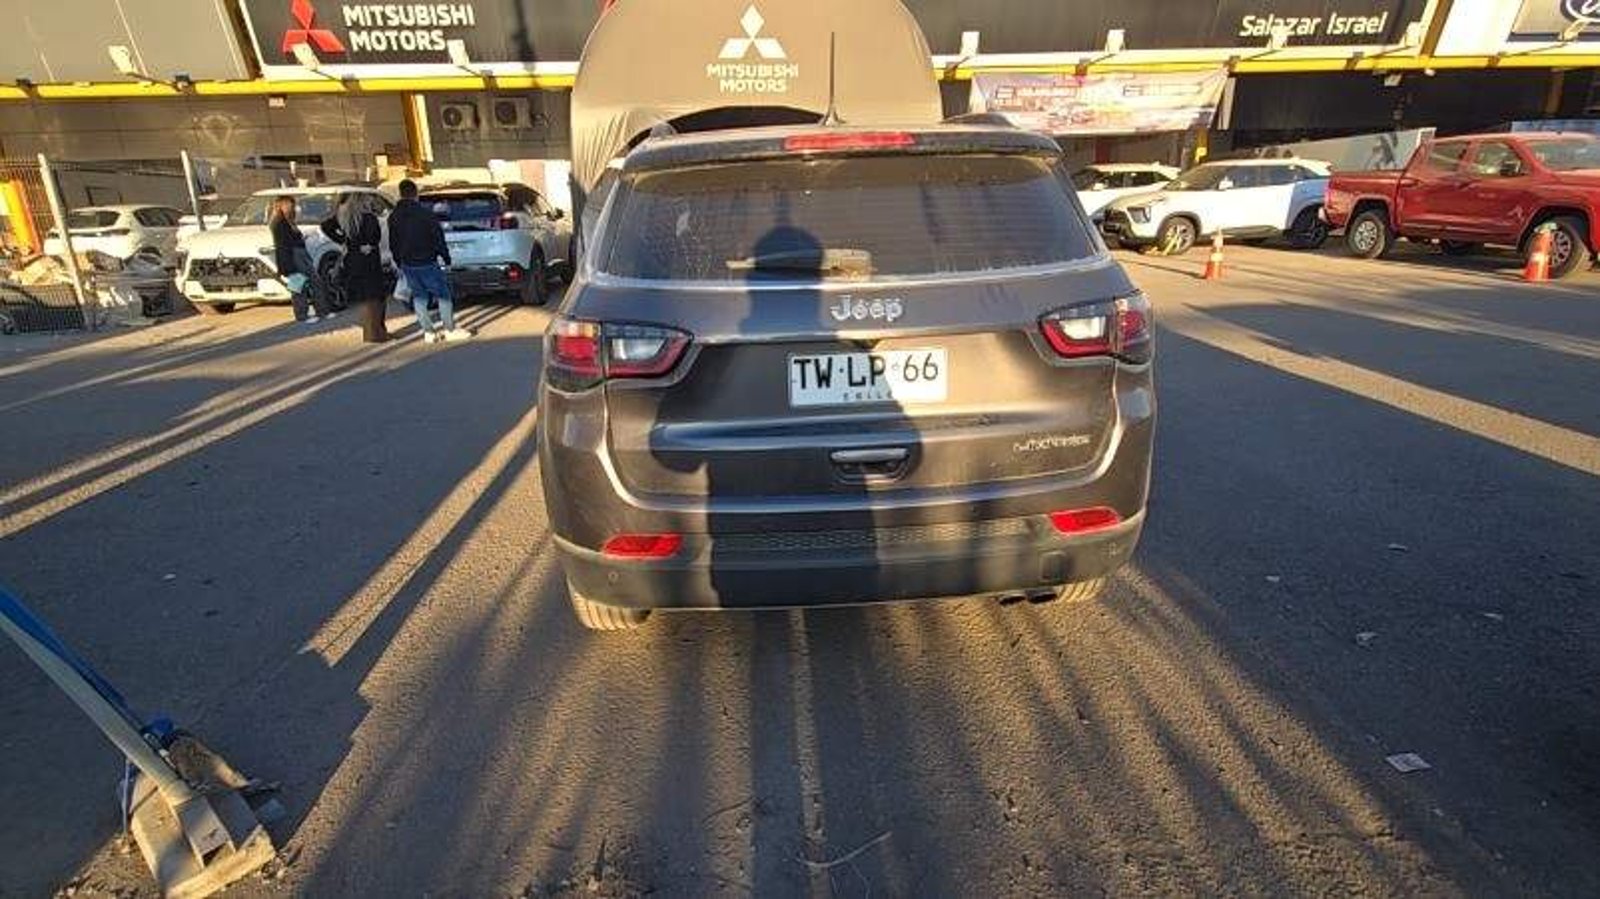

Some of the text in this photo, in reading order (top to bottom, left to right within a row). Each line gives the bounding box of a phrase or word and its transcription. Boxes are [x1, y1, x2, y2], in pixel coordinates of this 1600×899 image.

[342, 4, 475, 27] MITSUBISHI
[1239, 11, 1389, 36] Salazar Israel
[348, 29, 446, 51] MOTORS
[705, 63, 799, 79] MITSUBISHI
[719, 79, 786, 93] MOTORS
[829, 294, 903, 322] Jeep
